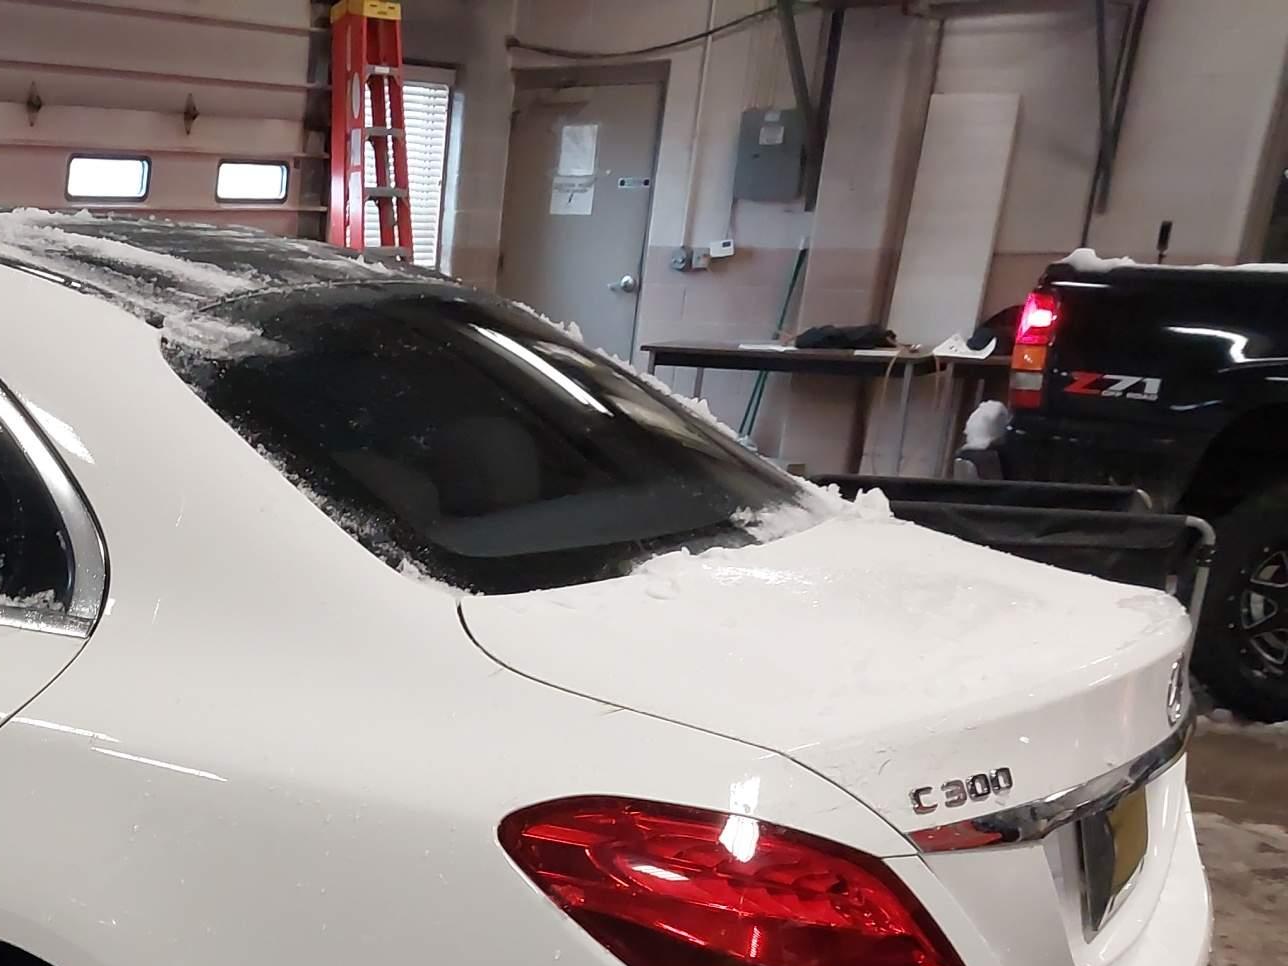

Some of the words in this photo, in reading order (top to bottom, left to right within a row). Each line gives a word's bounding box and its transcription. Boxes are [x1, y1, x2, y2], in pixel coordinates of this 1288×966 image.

[1063, 371, 1162, 396] Z71
[910, 785, 938, 815] C
[940, 766, 1013, 808] 300
